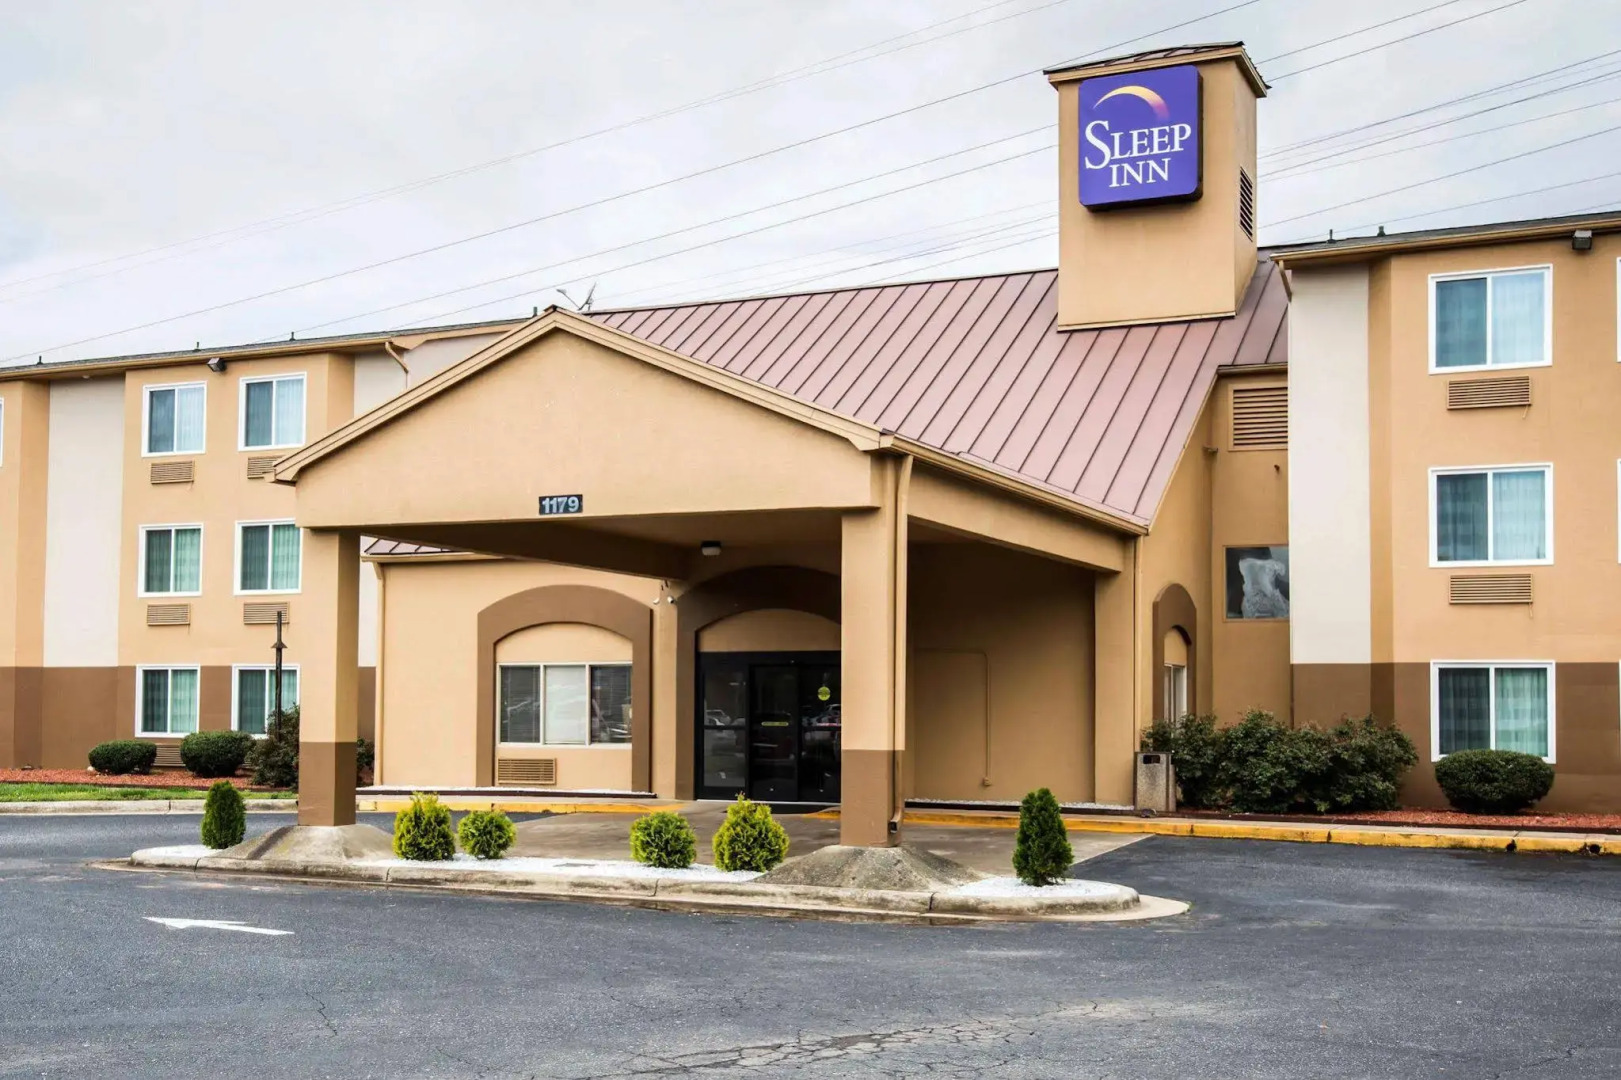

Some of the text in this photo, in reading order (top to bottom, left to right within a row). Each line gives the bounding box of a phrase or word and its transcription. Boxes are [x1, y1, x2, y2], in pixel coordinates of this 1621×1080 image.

[1084, 120, 1192, 170] SLEEP
[1109, 157, 1171, 188] INN
[542, 496, 580, 514] 1179
